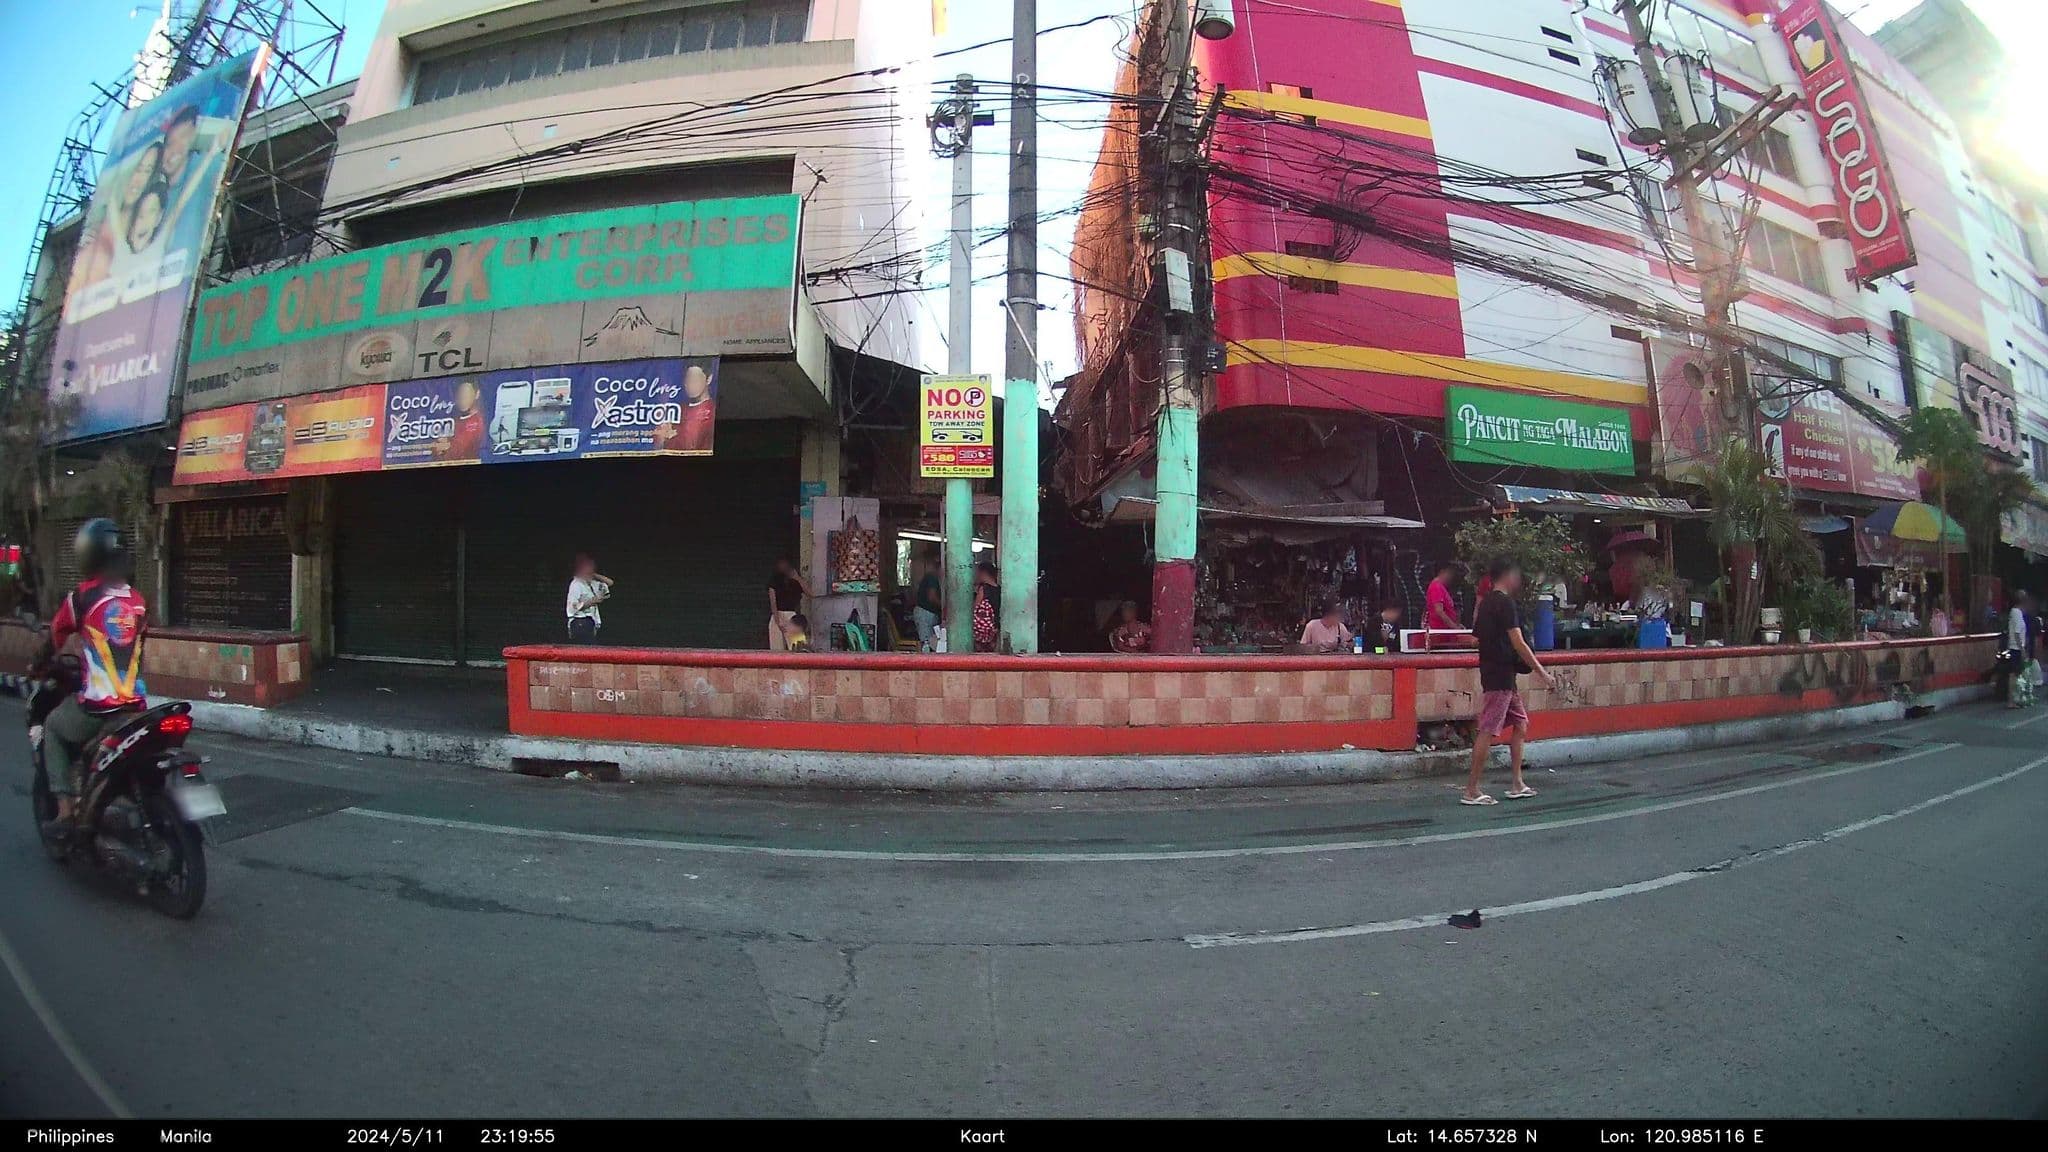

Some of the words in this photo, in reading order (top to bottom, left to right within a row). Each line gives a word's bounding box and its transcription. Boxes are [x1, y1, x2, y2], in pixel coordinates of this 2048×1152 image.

[1815, 78, 1889, 239] SOGO
[503, 213, 790, 267] ENTERPRISES
[575, 253, 696, 290] CORP.
[203, 285, 270, 347] TOP
[276, 259, 371, 335] ONE
[376, 236, 500, 317] M2K
[418, 347, 483, 373] TCL
[594, 377, 648, 394] Coco
[927, 388, 962, 407] NO
[390, 395, 430, 411] Coco
[927, 409, 985, 420] PARKING
[1457, 403, 1521, 446] PANCIT
[1555, 417, 1630, 453] MALABON
[1793, 409, 1815, 426] Half
[1818, 416, 1842, 432] Fried
[1804, 428, 1845, 447] Chicken
